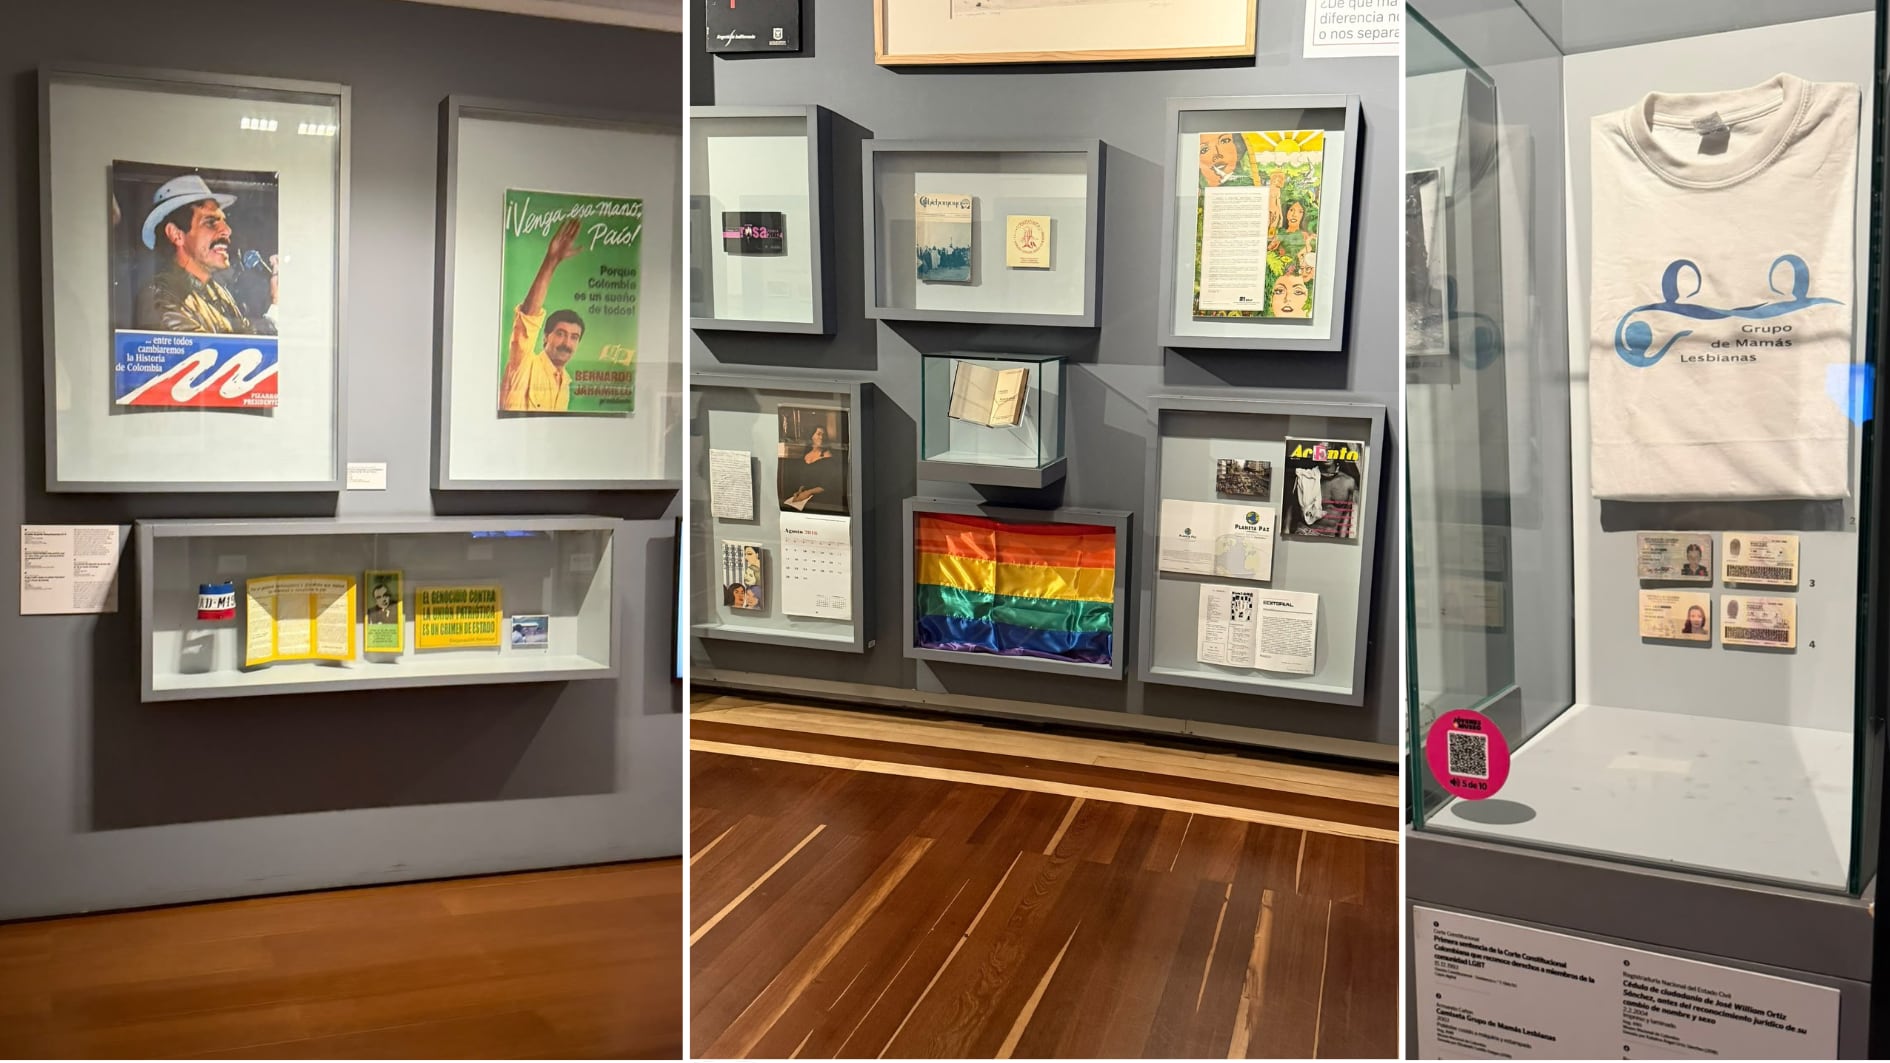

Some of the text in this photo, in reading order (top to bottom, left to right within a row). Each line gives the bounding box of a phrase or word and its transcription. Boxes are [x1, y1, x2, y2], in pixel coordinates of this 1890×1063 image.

[1320, 11, 1384, 25] diferencia
[1319, 31, 1327, 40] o
[1330, 30, 1354, 40] nos
[600, 265, 637, 278] Porque
[588, 278, 637, 290] Colombia
[574, 292, 586, 302] es
[588, 292, 602, 302] un
[588, 304, 600, 314] de
[1741, 324, 1793, 335] Grupo
[152, 337, 172, 345] entre
[173, 337, 193, 346] todos
[1710, 337, 1793, 349] de Mamás
[137, 345, 185, 354] cambiaremos
[126, 353, 166, 363] la Historia
[1680, 353, 1757, 363] Lesbianas
[115, 363, 163, 373] de Colombia
[1809, 579, 1816, 588] 3
[422, 623, 430, 636] ES
[1809, 640, 1816, 649] 4
[1462, 780, 1488, 791] 5 de 10
[1433, 934, 1567, 969] Primera sentencia de la Corte Constitucional
[1433, 953, 1485, 969] comunidad LGBT
[1433, 943, 1470, 957] Colombiana
[1470, 951, 1483, 960] que
[1511, 959, 1540, 972] derechos
[1578, 974, 1588, 982] de
[1588, 975, 1596, 984] la
[1622, 979, 1787, 1020] Cédula de ciudadanía de José William Ortiz
[1622, 999, 1650, 1010] cambio
[1661, 1008, 1691, 1019] nombre
[1698, 1016, 1716, 1025] sexo
[1656, 998, 1678, 1007] antes
[1679, 1001, 1692, 1010] del
[1692, 1005, 1753, 1023] reconocimiento
[1753, 1015, 1785, 1030] jurídico
[1784, 1023, 1796, 1032] de
[1796, 1027, 1808, 1035] su
[1435, 1008, 1466, 1020] Camiseta
[1466, 1014, 1487, 1025] Grupo
[1497, 1021, 1522, 1034] Mamás
[1522, 1027, 1557, 1042] Lesbianas
